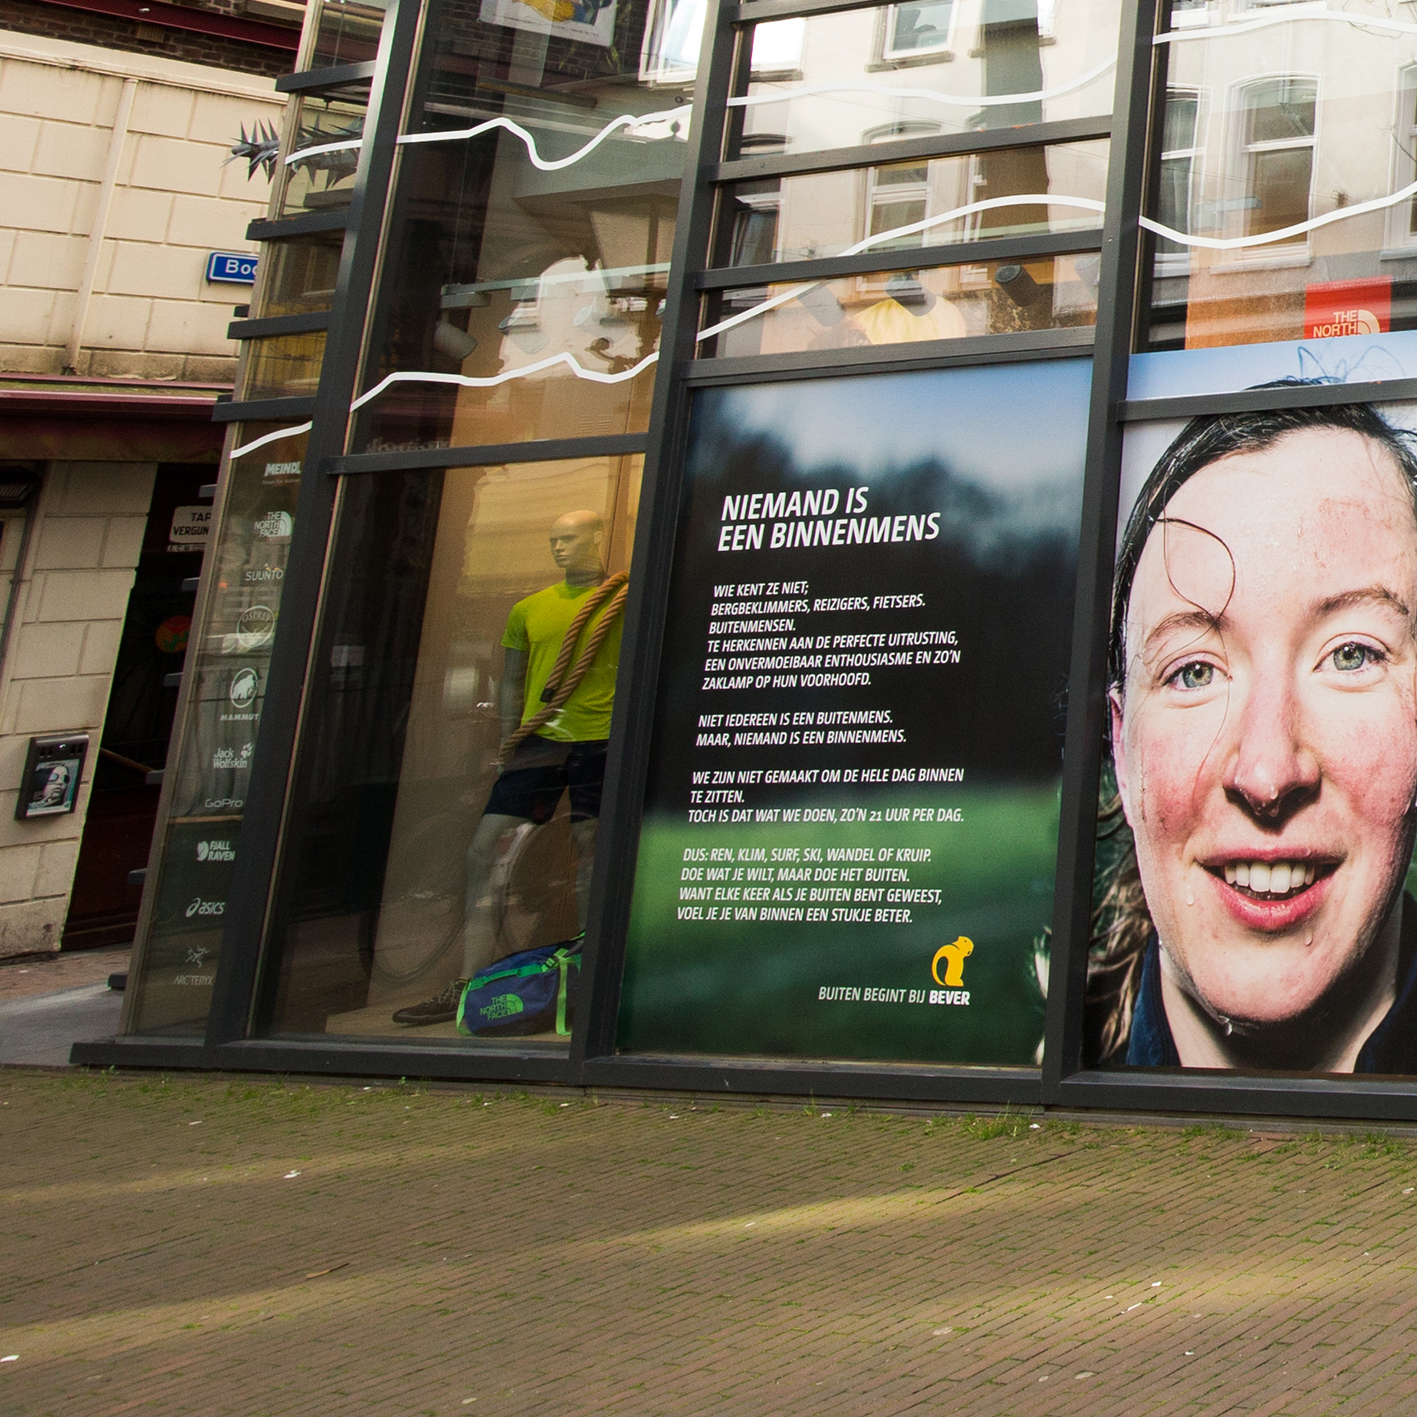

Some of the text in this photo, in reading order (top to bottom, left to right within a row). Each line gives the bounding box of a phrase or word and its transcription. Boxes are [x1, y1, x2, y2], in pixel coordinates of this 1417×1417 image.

[1333, 310, 1357, 324] THE
[1312, 322, 1357, 338] NORTH
[264, 461, 301, 477] MEINDL
[722, 487, 869, 520] NIEMAND IS
[718, 513, 939, 551] EEN BINNENMENS
[245, 570, 284, 581] SUUNTO
[714, 581, 808, 597] WIE KENT ZE NIET;
[712, 594, 925, 615] BERGBEKLIMMERS, REIZIGERS, FIETSERS.
[709, 619, 795, 634] BUITENMENSEN.
[708, 631, 957, 652] TE HERKENNEN AAN DE PERFECTE UITRUSTING,
[705, 659, 726, 671] EEN
[728, 655, 822, 670] ONVERMOEIBAAR
[825, 652, 913, 667] ENTHOUSIASME
[916, 651, 932, 664] EN
[702, 673, 870, 690] ZAKLAMP OP HUN VOORHOOFD.
[220, 713, 259, 721] MAMMUT
[698, 710, 892, 727] NIET IEDEREEN IS EEN BUITENMENS.
[696, 729, 906, 747] MAAR, NIEMAND IS EEN BINNENMENS.
[214, 748, 234, 758] Jack
[213, 757, 248, 769] Wolfskin
[693, 768, 964, 784] WE ZIJN NIET GEMAAKT OM DE HELE DAG BINNEN
[205, 798, 243, 808] GoPro
[691, 790, 744, 803] TE ZITTEN.
[689, 809, 717, 823] TOCH
[718, 809, 729, 823] IS
[731, 809, 753, 822] DAT
[756, 809, 781, 822] WAT
[783, 809, 801, 822] WE
[803, 808, 837, 823] DOEN,
[869, 811, 882, 821] 21
[885, 808, 910, 821] UUR
[912, 808, 934, 821] PER
[937, 808, 964, 822] DAG.
[683, 848, 931, 863] DUS: REN, KLIM, SURF, SKI, WANDEL OF KRUIP.
[681, 867, 909, 882] DOE WAT JE WILT, MAAR DOE HET BUITEN.
[680, 887, 942, 904] WANT ELKE KEER ALS JE BUITEN BENT GEWEEST,
[198, 902, 226, 915] asics
[819, 987, 970, 1005] BUITEN BEGINT BIJ BEVER
